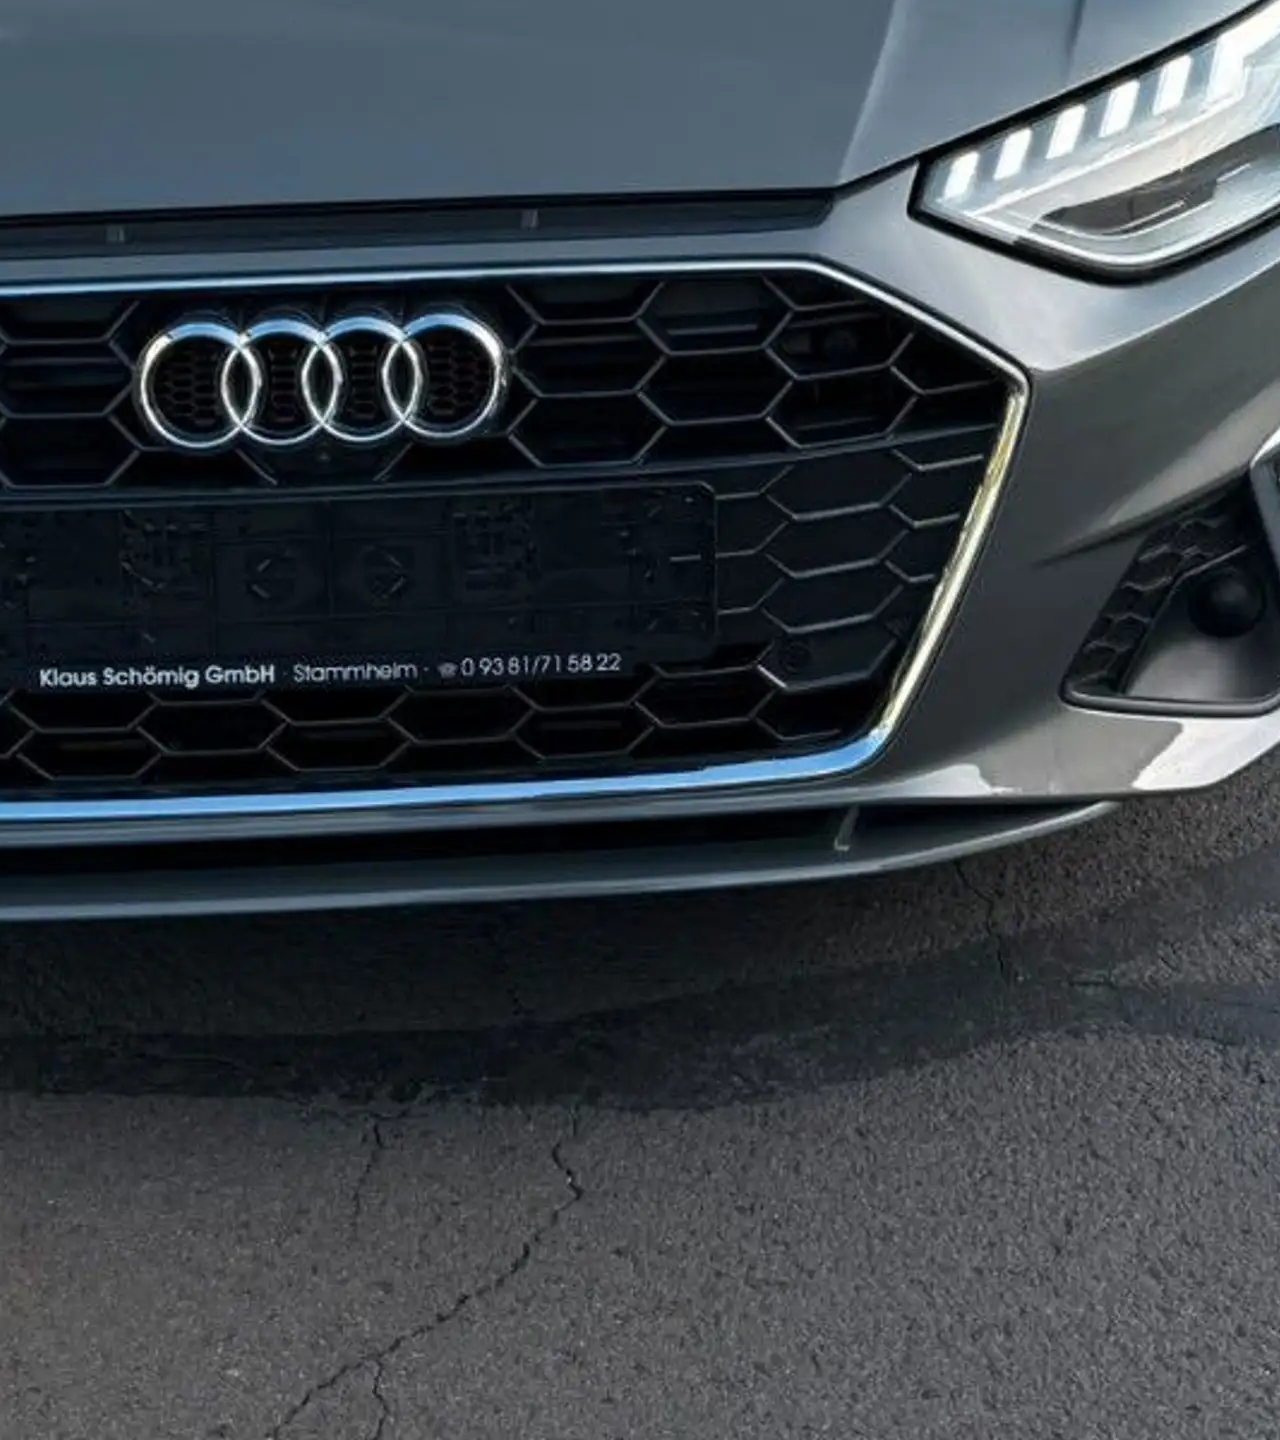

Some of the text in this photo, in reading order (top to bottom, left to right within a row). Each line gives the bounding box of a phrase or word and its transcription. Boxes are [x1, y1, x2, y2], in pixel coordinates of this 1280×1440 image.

[39, 667, 97, 687] Klaus
[102, 666, 200, 689] Schömig
[205, 664, 275, 685] GmbH
[293, 661, 418, 682] Stammheim
